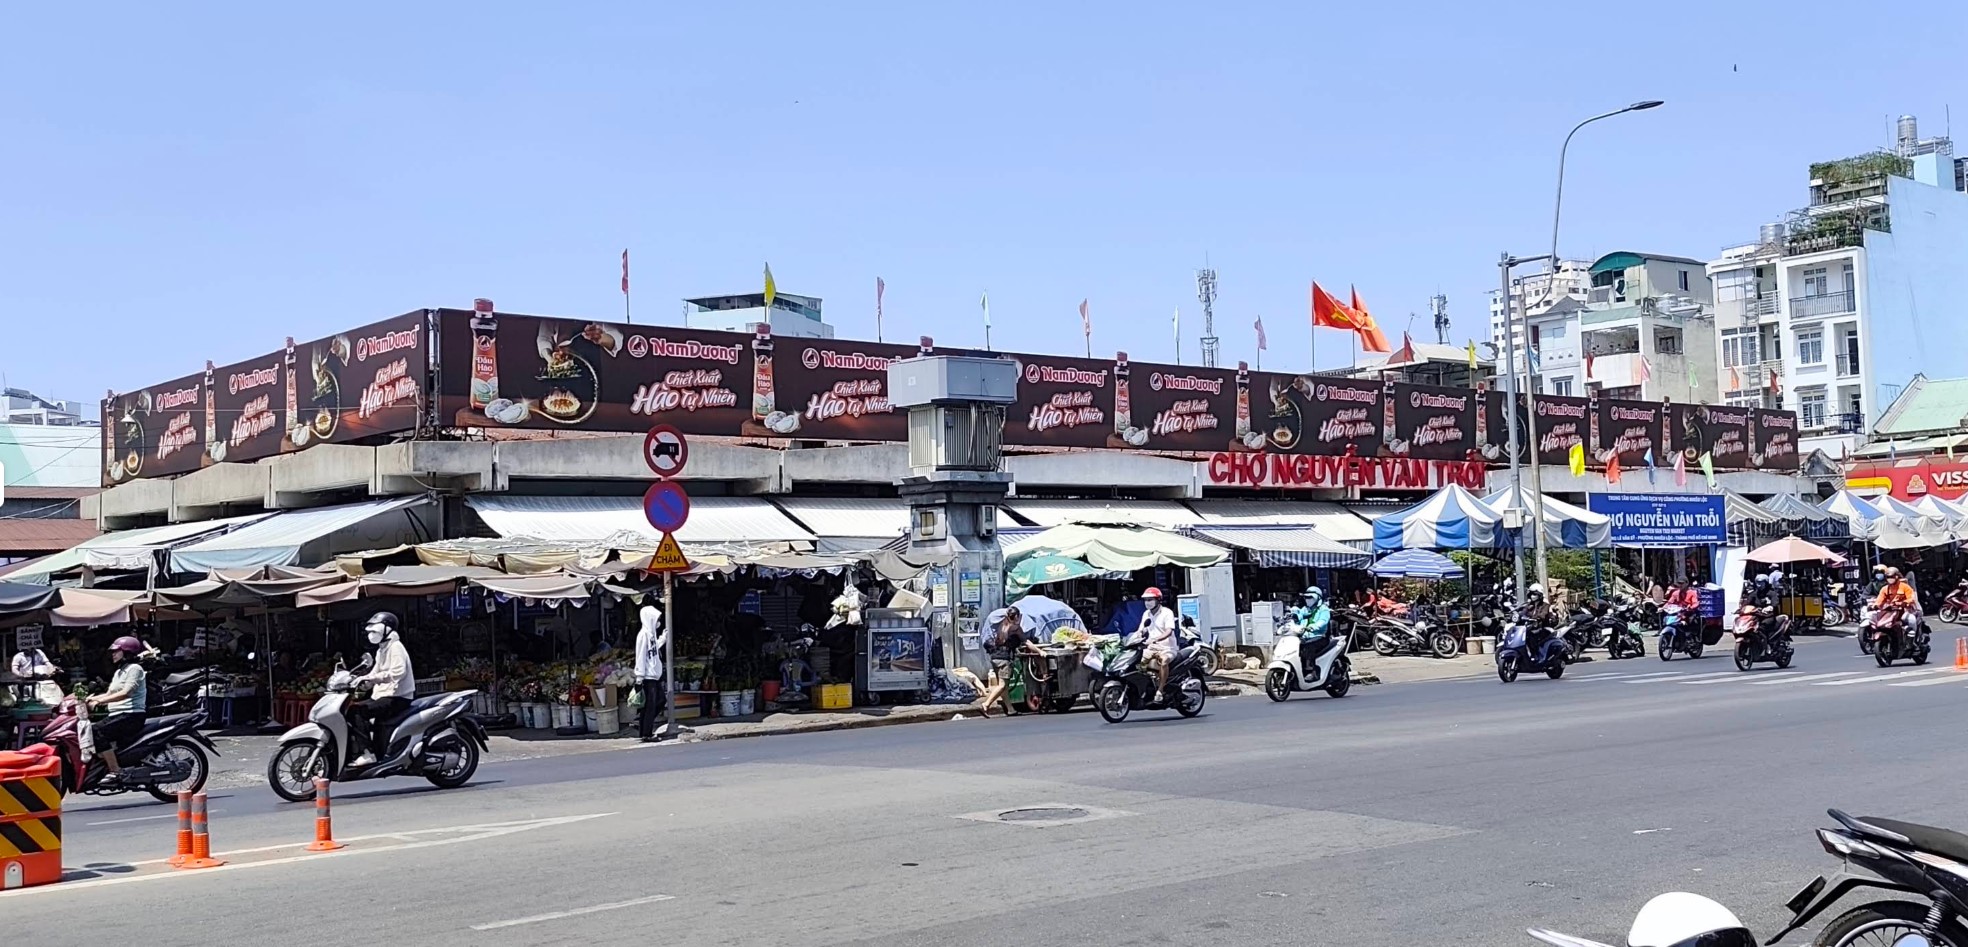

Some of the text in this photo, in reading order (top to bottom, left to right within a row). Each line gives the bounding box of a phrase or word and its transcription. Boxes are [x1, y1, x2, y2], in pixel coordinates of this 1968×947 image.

[665, 369, 722, 387] Chiết Xuất
[834, 379, 881, 396] Chiết Xuất
[630, 382, 737, 415] Hào Tự Nhiên
[805, 391, 846, 421] Hào
[846, 397, 862, 417] Tự
[1052, 391, 1093, 407] Chiết Xuất
[1028, 403, 1104, 431] Hào Tự Nhiên
[1152, 409, 1218, 435] Hào Tự Nhiên
[1318, 418, 1344, 442] Hào
[1413, 425, 1435, 446] Hào
[1208, 450, 1267, 489] CHỢ
[1626, 508, 1670, 527] NGUYỄN
[1672, 511, 1693, 527] VĂN
[1695, 508, 1719, 527] TRỖI
[664, 544, 673, 552] ĐI
